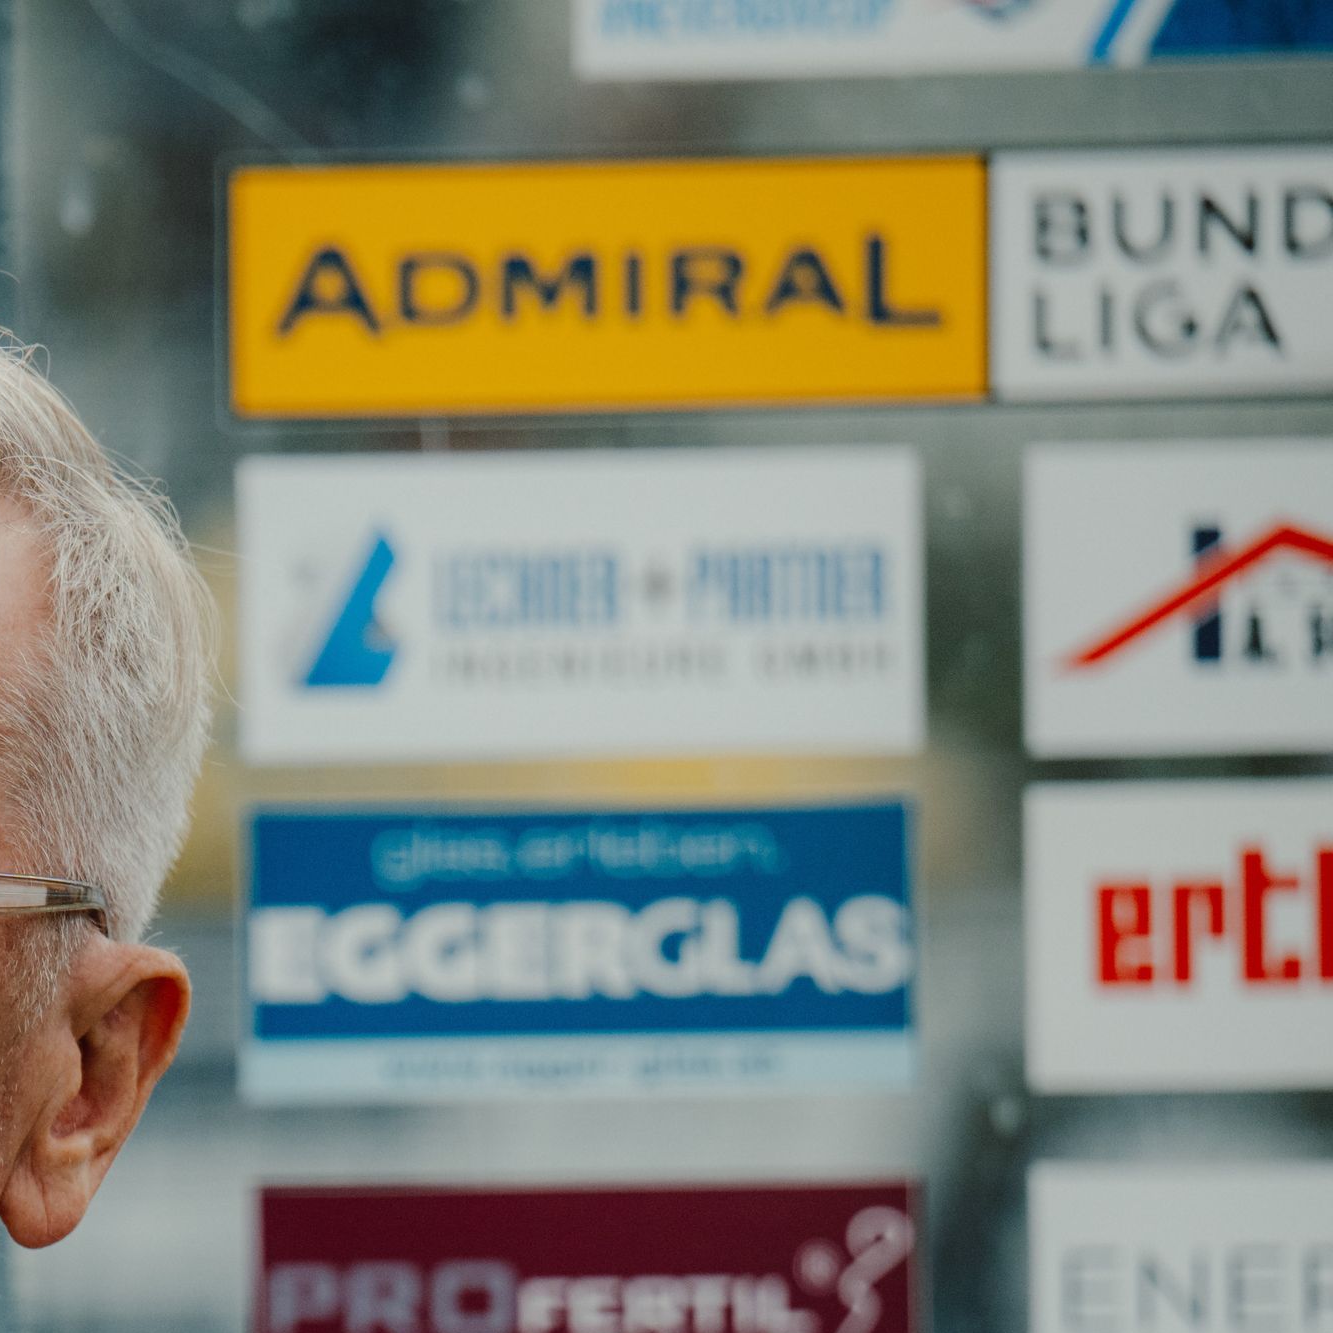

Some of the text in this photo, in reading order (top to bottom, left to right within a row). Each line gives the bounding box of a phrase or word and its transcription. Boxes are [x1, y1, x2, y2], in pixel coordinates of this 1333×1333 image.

[275, 232, 943, 338] ADMIRAL
[1032, 281, 1284, 358] LIGA
[247, 897, 915, 1006] EGGERGLAS
